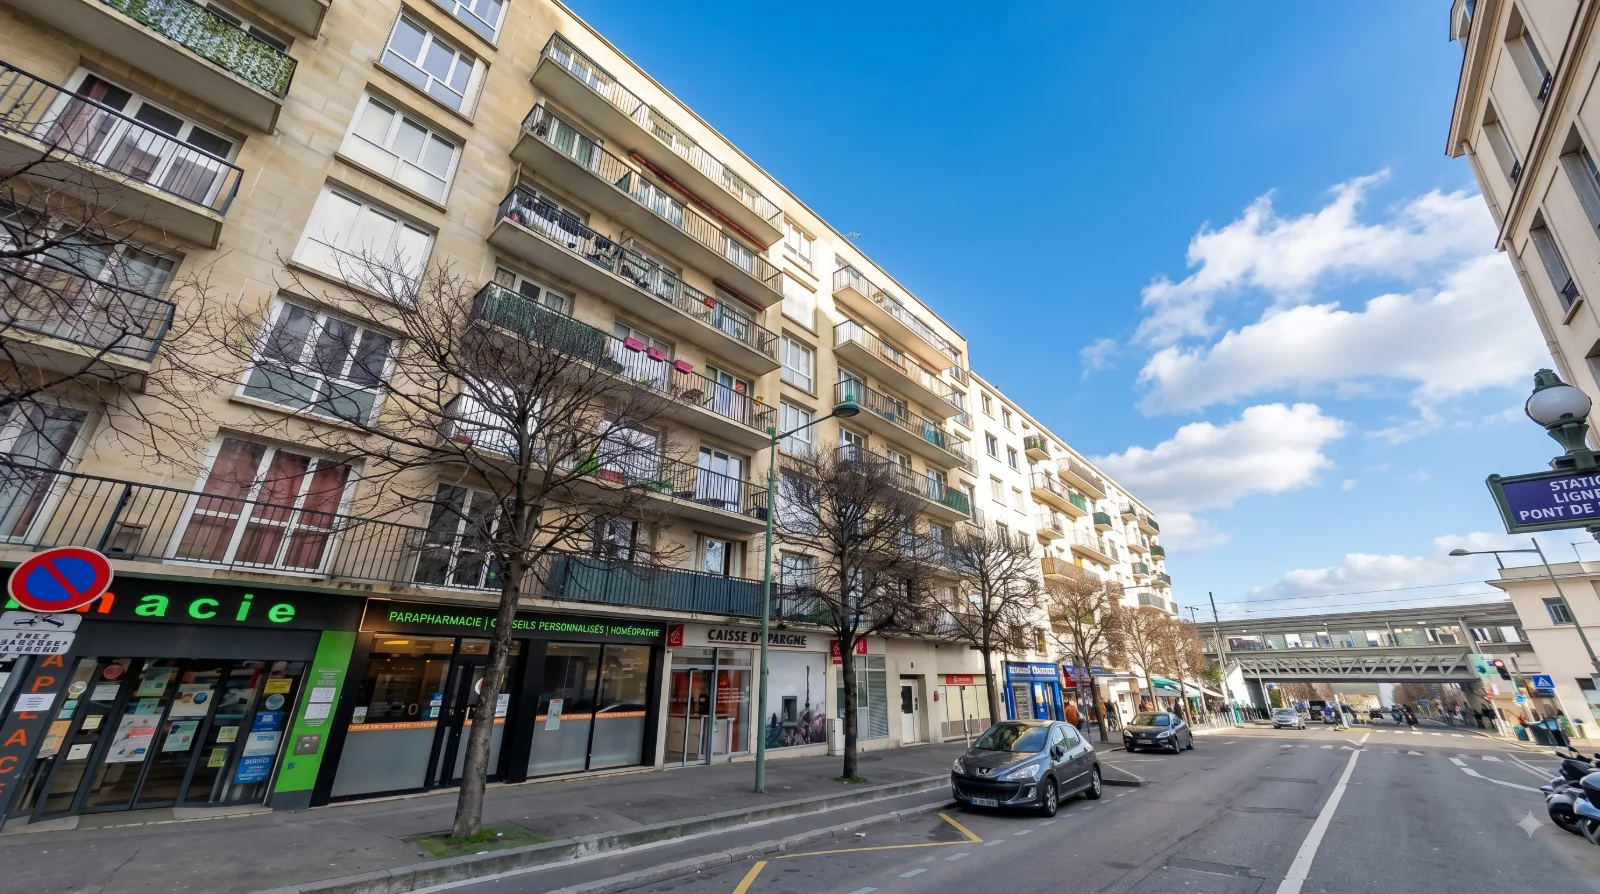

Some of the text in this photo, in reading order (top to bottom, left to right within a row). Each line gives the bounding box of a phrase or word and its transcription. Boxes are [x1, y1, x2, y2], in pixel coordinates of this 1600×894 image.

[1519, 506, 1564, 521] PONT
[1569, 503, 1594, 515] DE
[389, 611, 483, 627] PARAPHARMACIE
[491, 618, 537, 630] CSEILS
[538, 621, 604, 634] PERSONNALISÉS
[610, 625, 660, 637] HOMÉOPATHIE
[708, 628, 807, 646] CAISSE D'PARGNE
